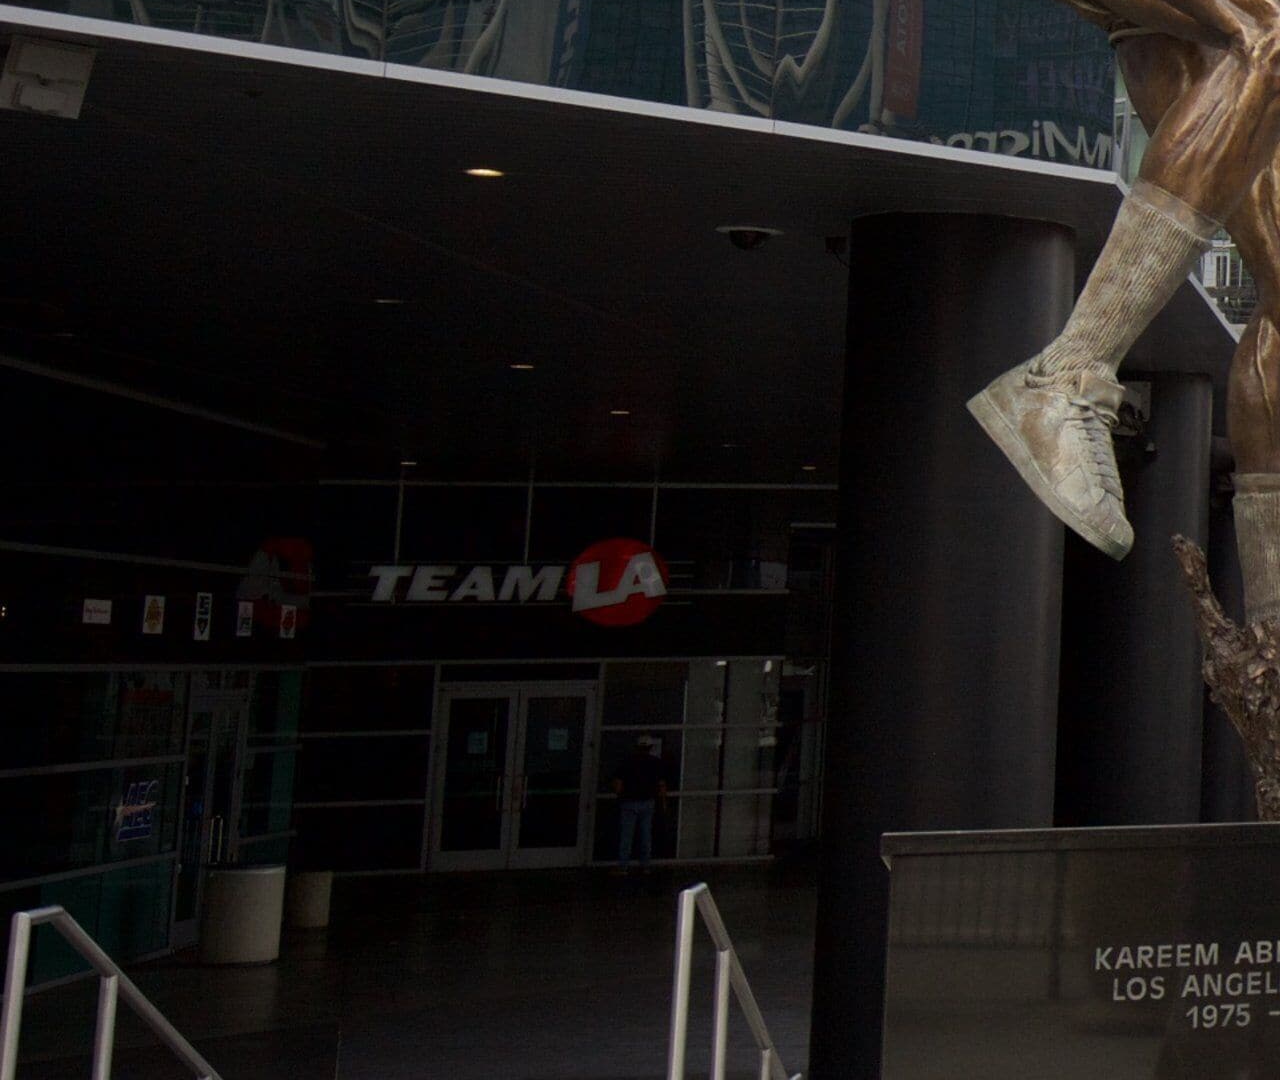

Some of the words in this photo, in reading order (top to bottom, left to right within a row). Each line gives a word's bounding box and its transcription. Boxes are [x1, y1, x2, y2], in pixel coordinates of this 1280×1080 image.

[368, 564, 567, 603] TEAM
[571, 551, 669, 613] LA
[1094, 942, 1220, 971] KAREEM
[1112, 975, 1166, 1001] LOS
[1185, 1003, 1252, 1030] 1975
